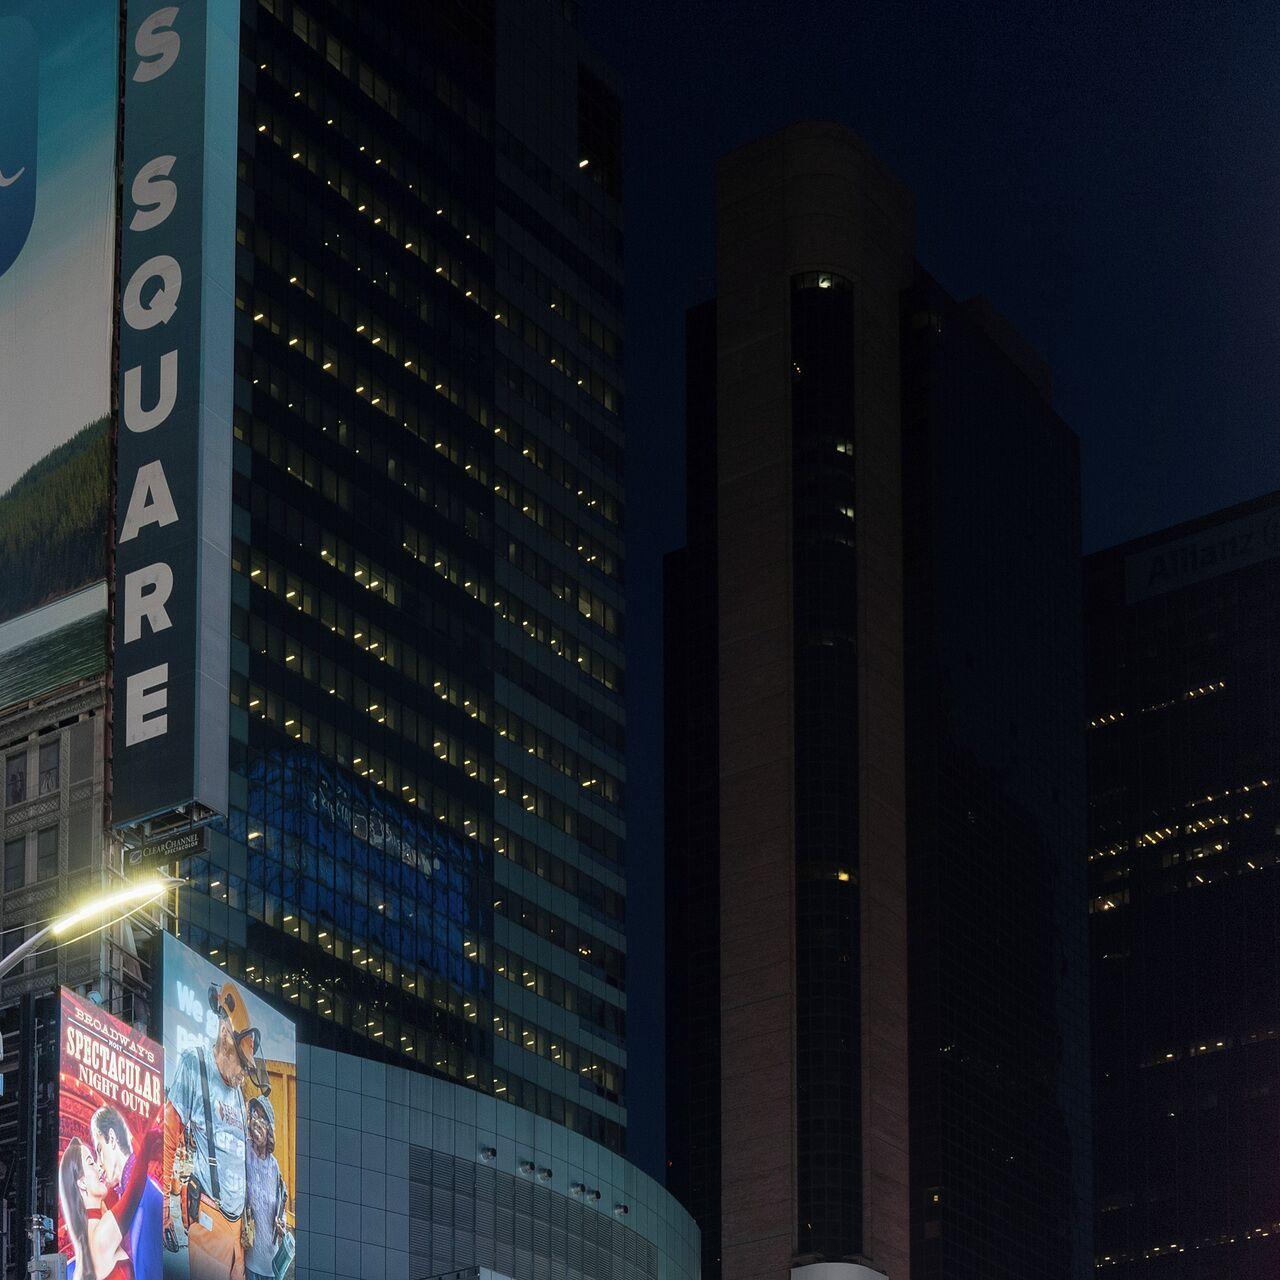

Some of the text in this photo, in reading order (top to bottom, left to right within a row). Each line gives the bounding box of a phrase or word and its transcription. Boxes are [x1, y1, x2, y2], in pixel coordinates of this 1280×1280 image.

[119, 155, 182, 748] SQUARE
[66, 1025, 161, 1106] SPECTACULAR
[74, 1006, 155, 1063] BROADWAY'S
[79, 1063, 150, 1119] NIGHT OUT!
